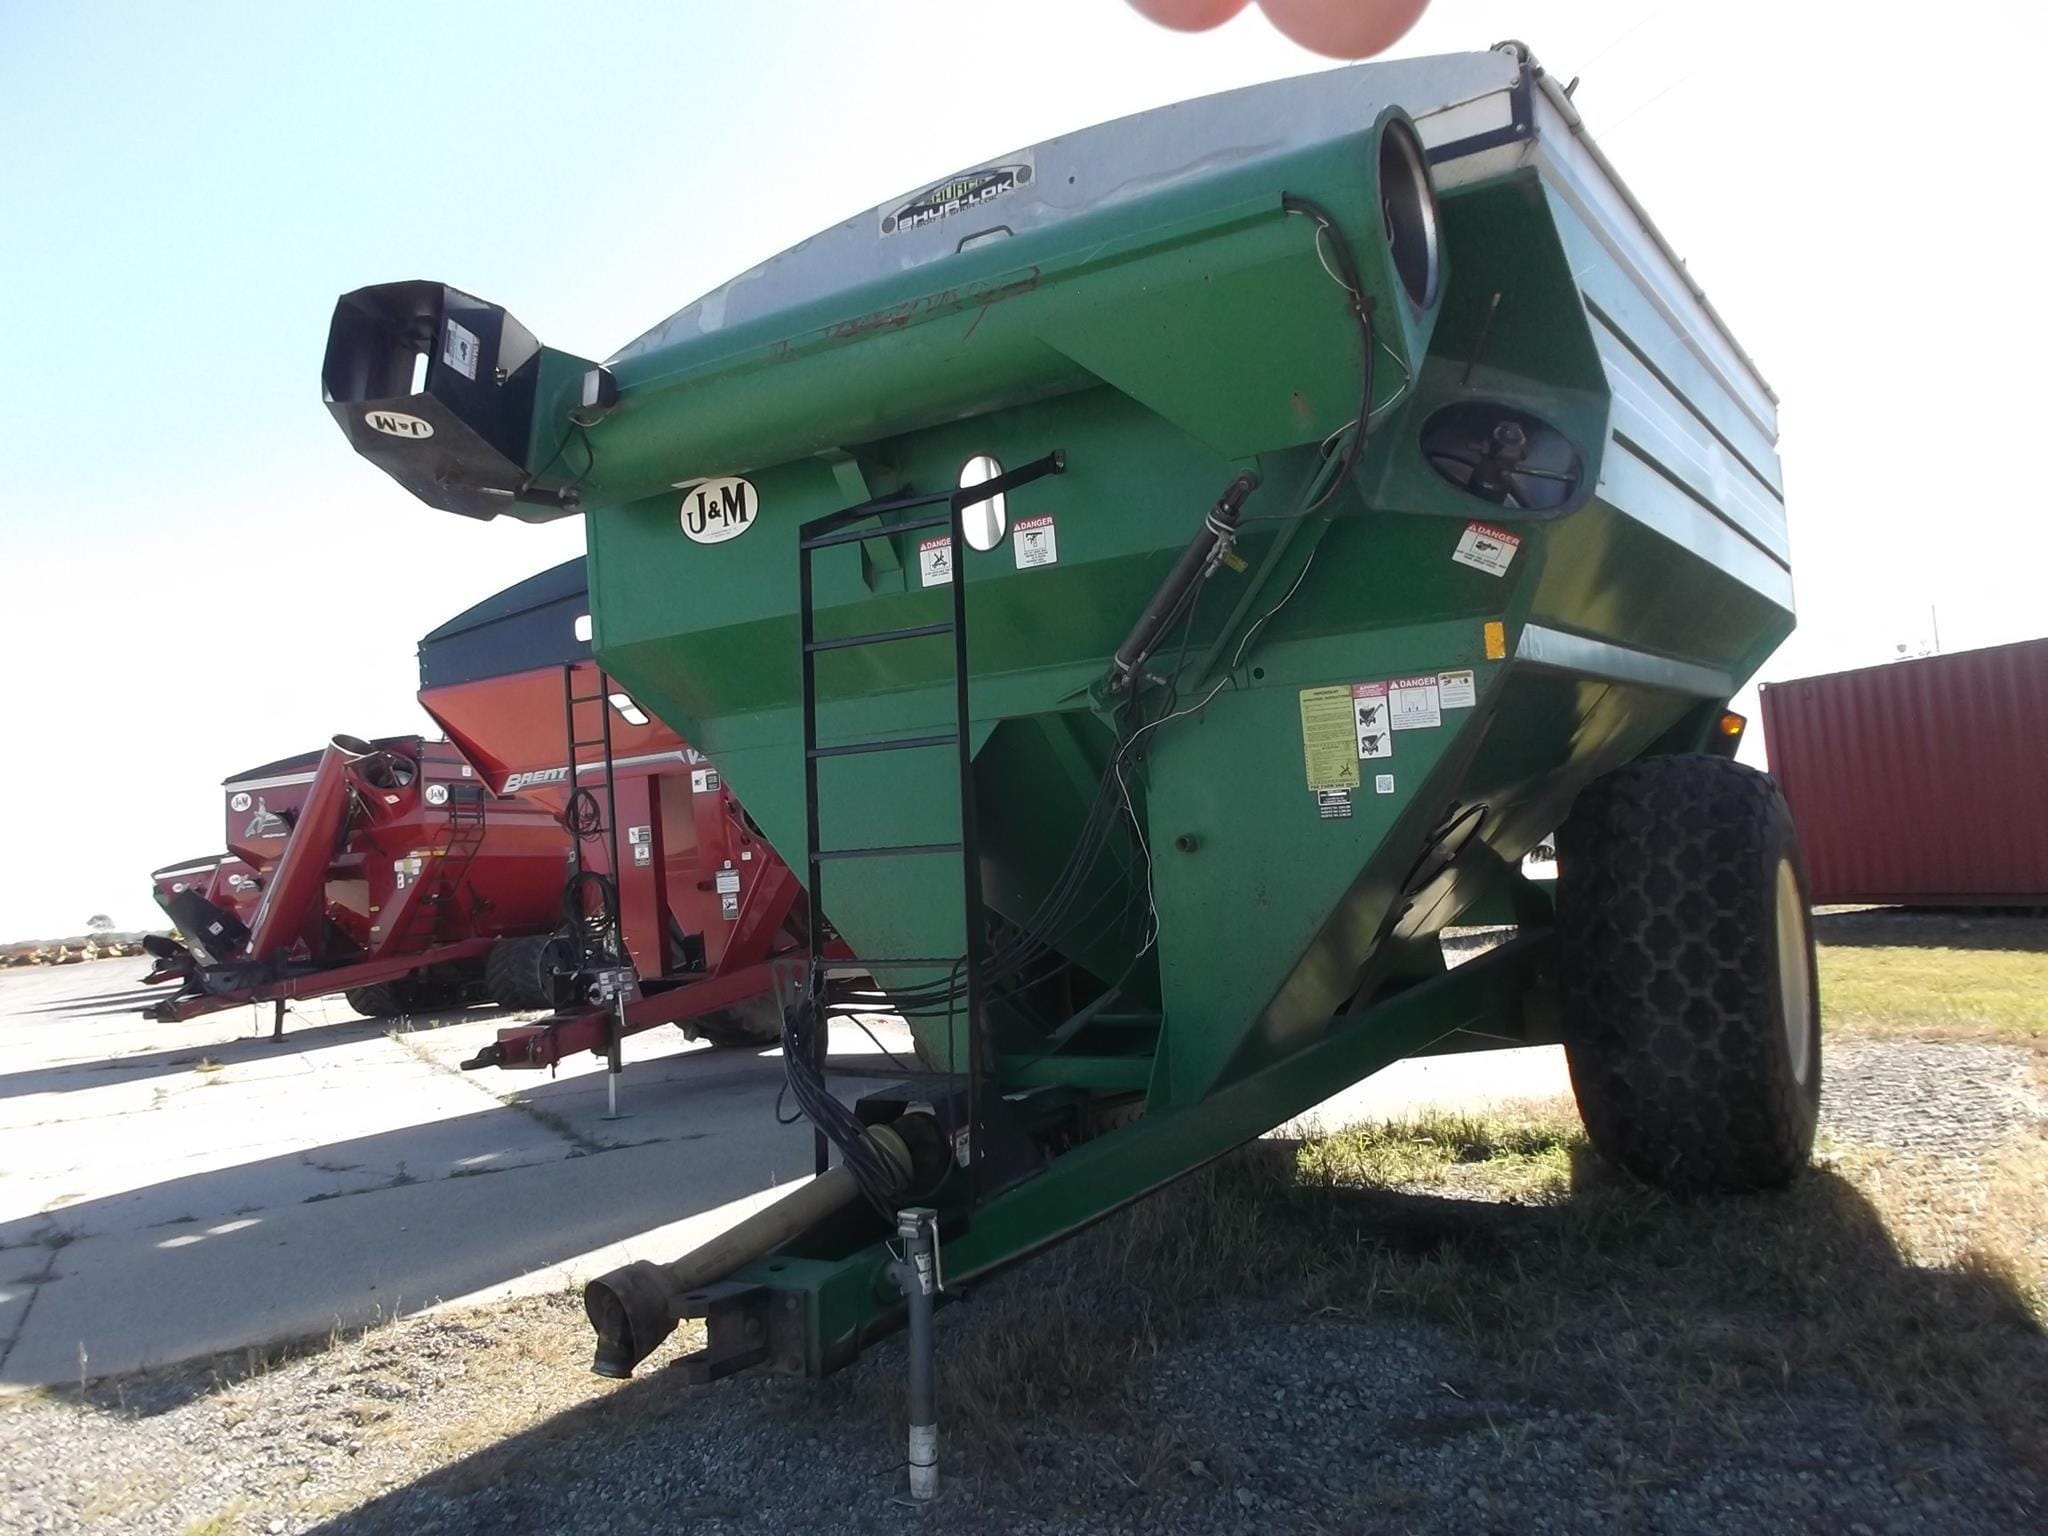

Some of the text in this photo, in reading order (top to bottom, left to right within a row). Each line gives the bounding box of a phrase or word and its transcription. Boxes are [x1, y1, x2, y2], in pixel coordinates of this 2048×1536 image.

[898, 178, 1014, 231] SHUR-LOK
[374, 415, 428, 436] J&M
[686, 482, 749, 534] J&M
[1021, 517, 1053, 530] DANGER
[926, 538, 951, 549] DANGE
[1477, 526, 1521, 546] DANGER
[1400, 677, 1437, 688] DANGER
[502, 767, 569, 793] BRENT
[428, 788, 445, 801] J&M
